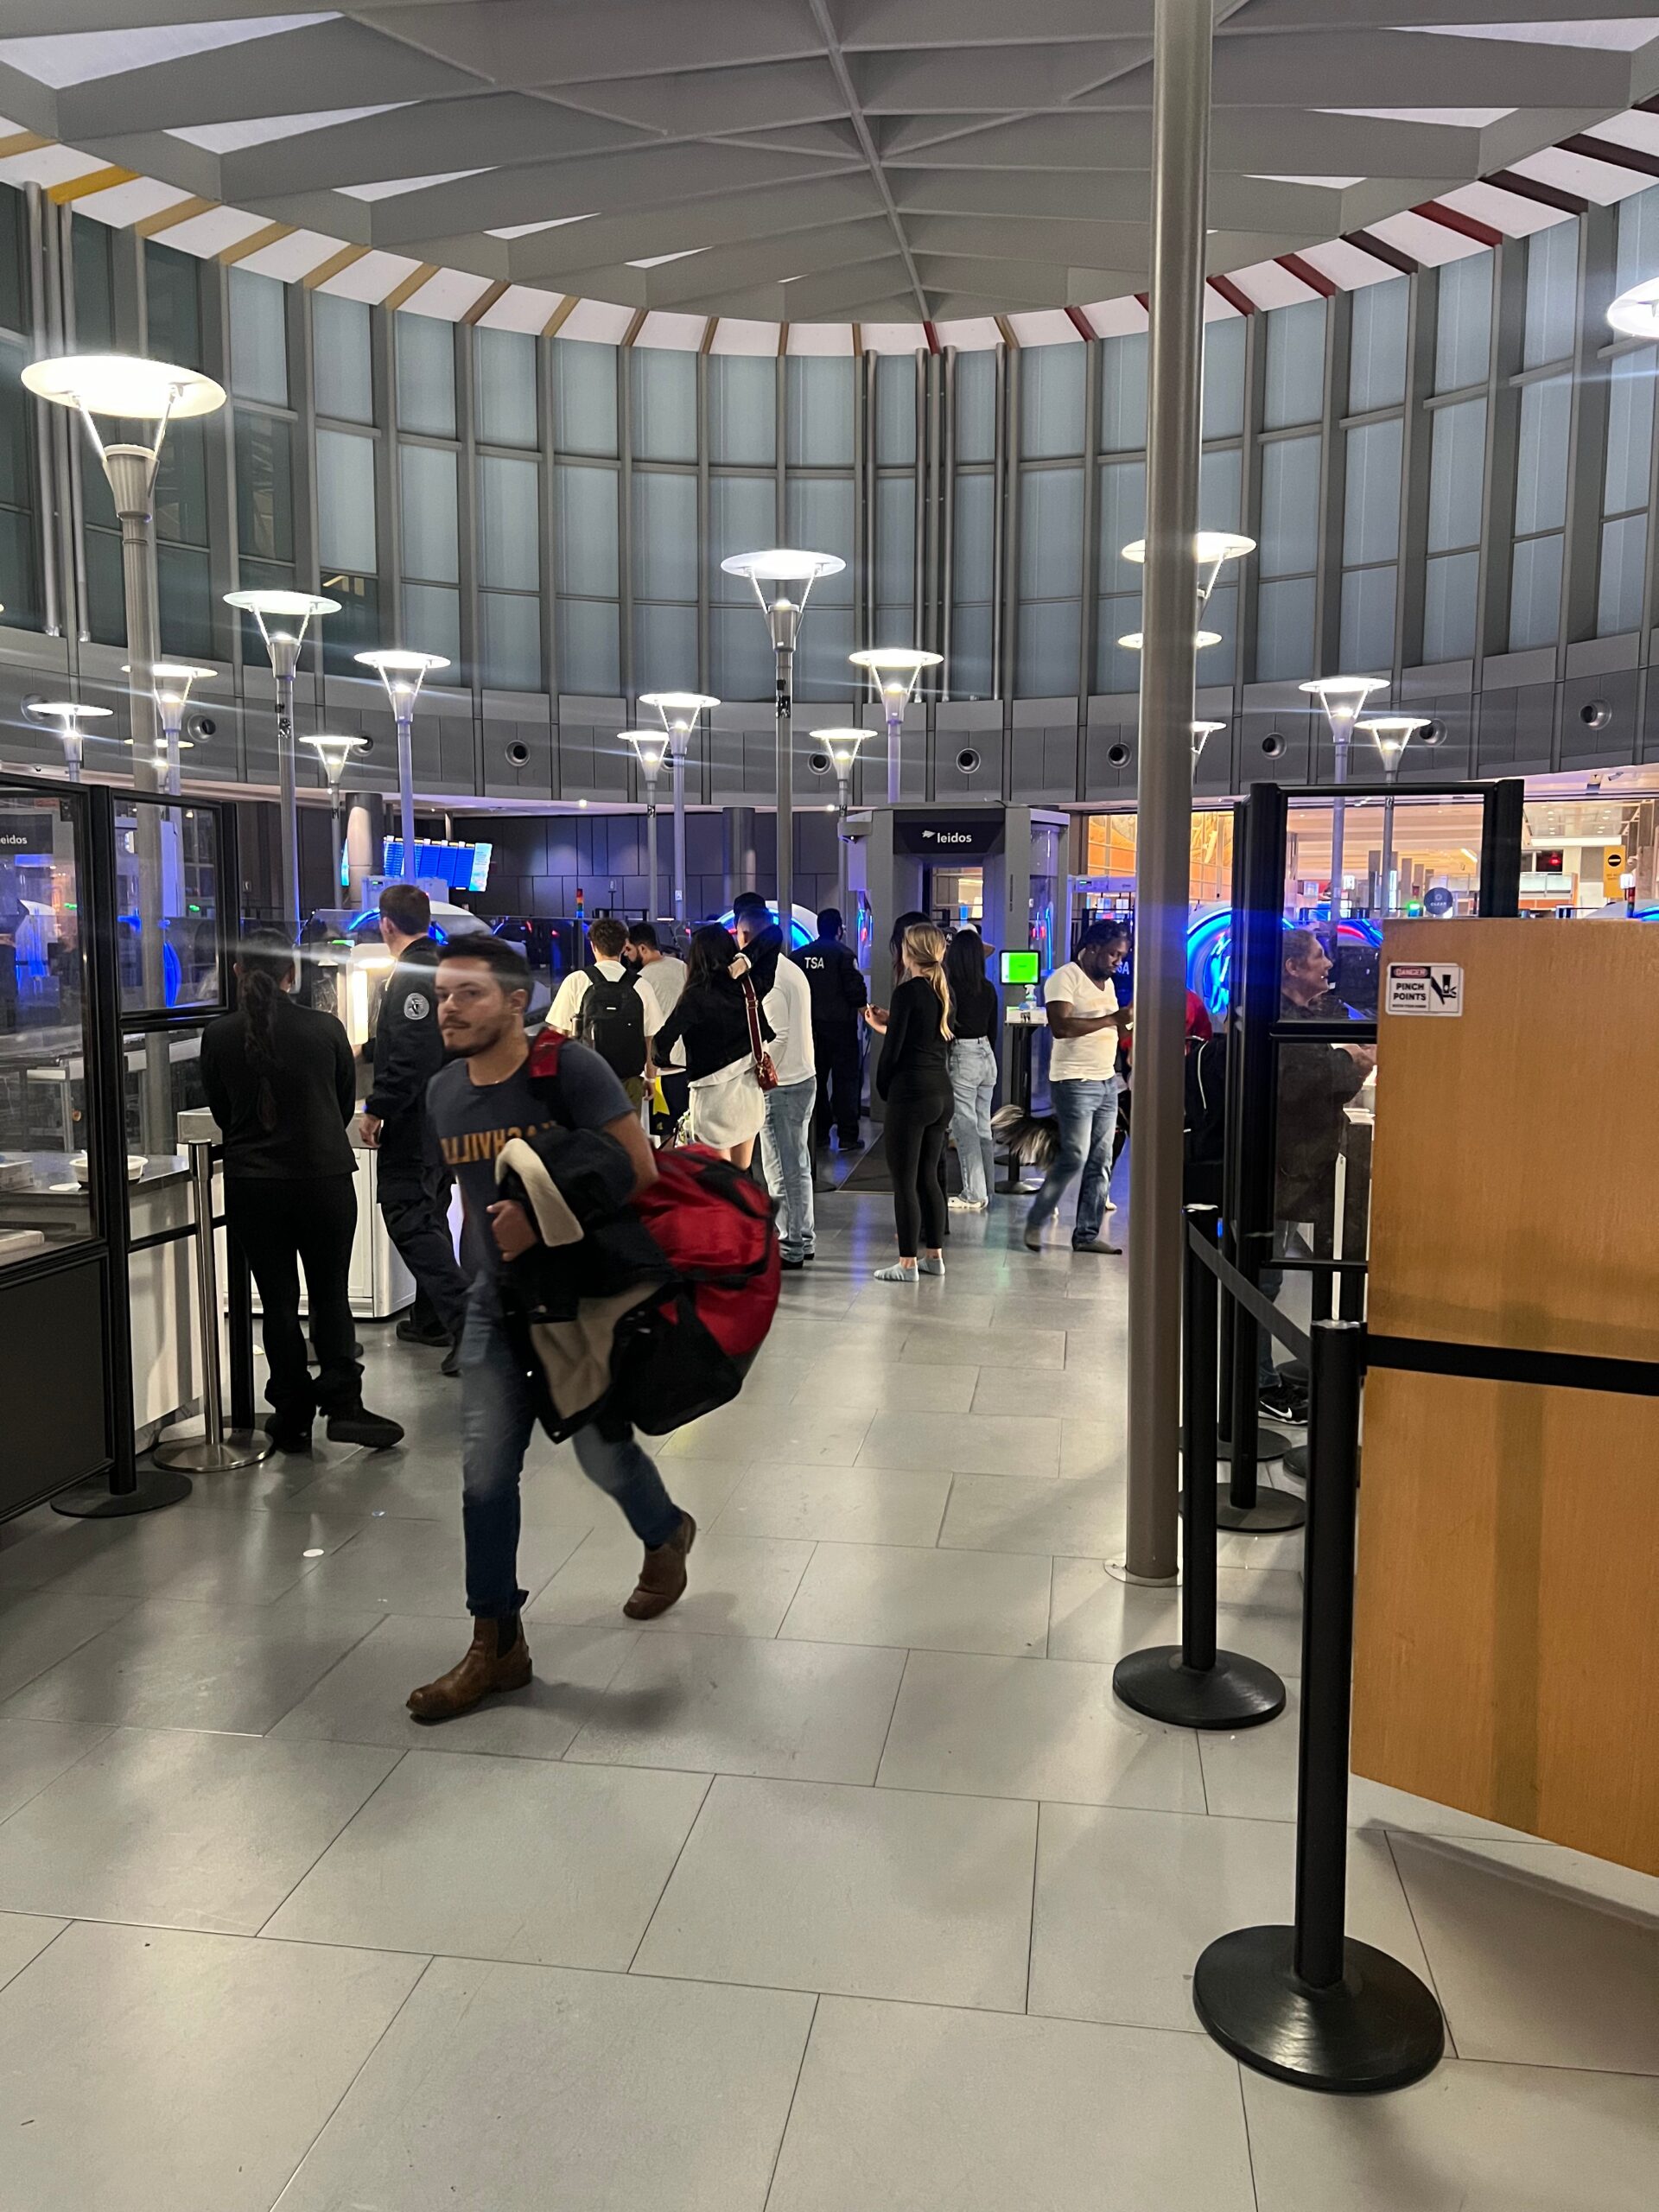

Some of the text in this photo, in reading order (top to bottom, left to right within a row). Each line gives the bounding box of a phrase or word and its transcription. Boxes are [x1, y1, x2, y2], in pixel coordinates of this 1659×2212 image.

[0, 835, 28, 844] eidos
[937, 832, 972, 843] leidos
[804, 957, 824, 969] TSA
